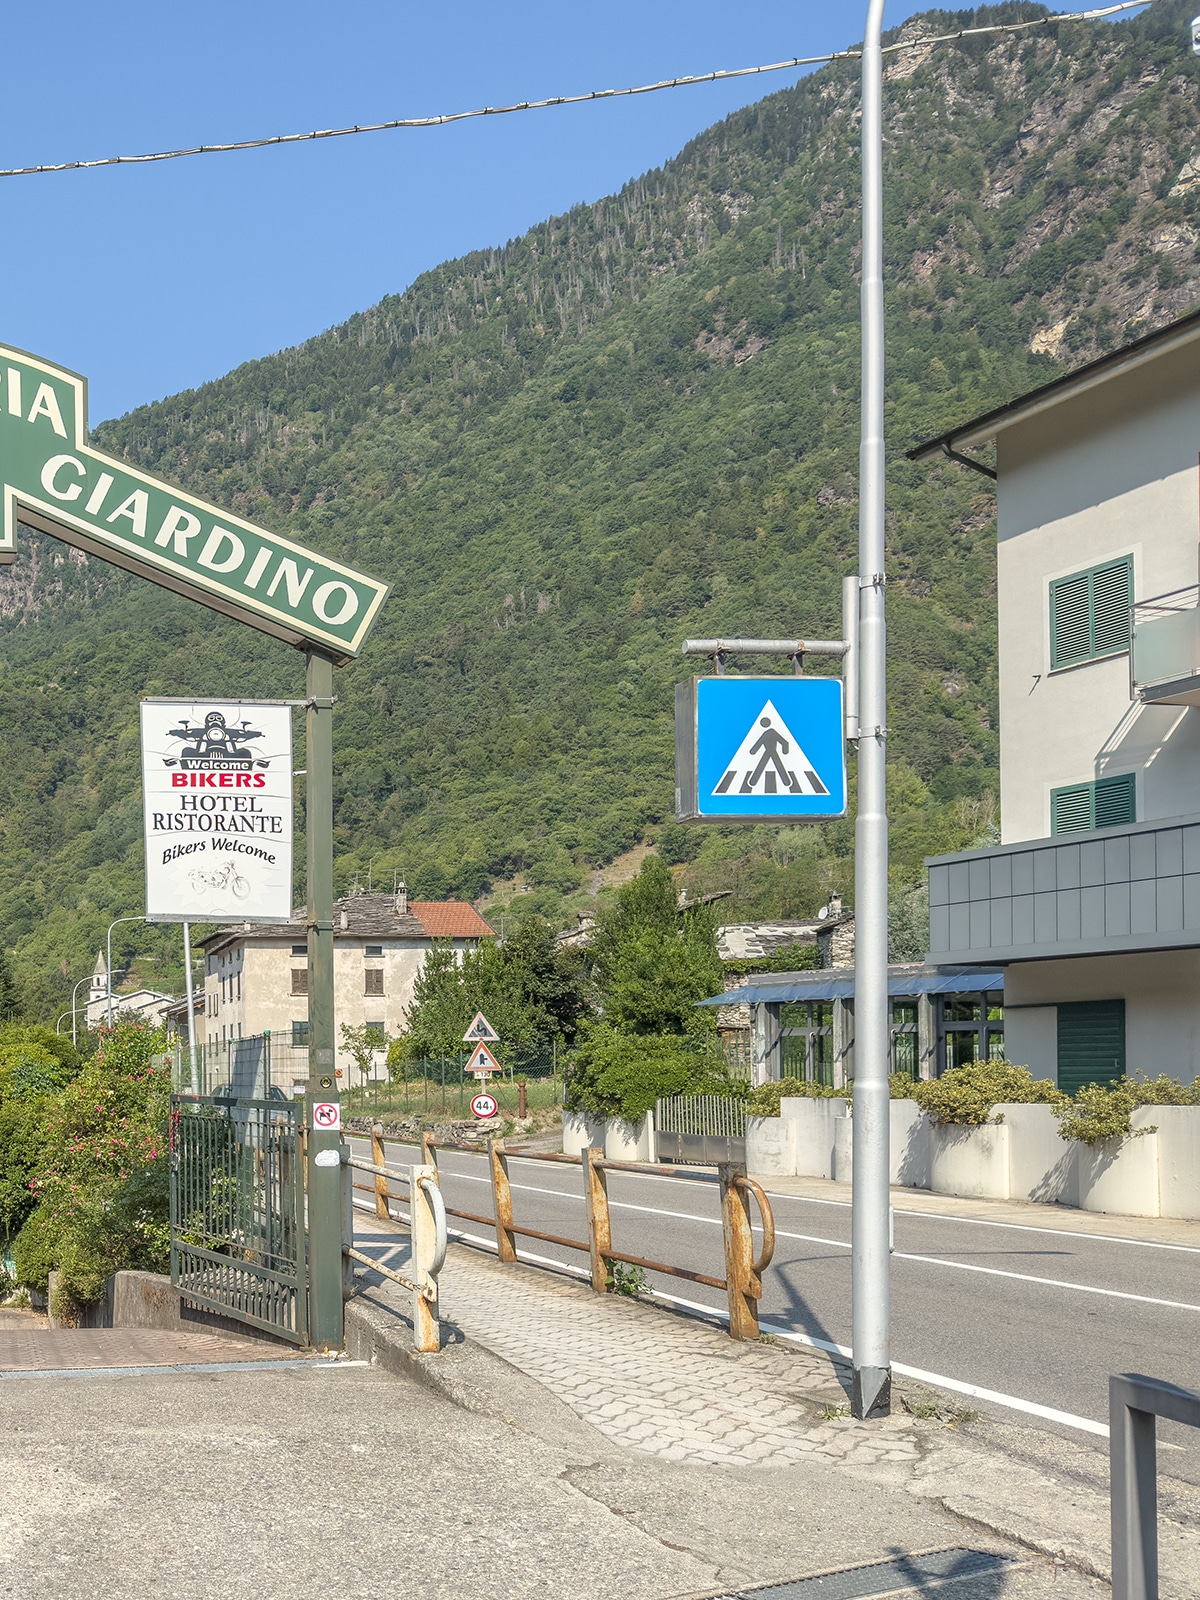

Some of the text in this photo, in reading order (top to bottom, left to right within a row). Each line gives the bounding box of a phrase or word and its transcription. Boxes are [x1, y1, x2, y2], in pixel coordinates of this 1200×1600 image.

[40, 454, 359, 625] GIARDINO
[186, 759, 250, 770] Welcome
[171, 773, 266, 788] BIKERS
[180, 795, 263, 813] HOTEL
[152, 813, 283, 834] RISTORANTE
[162, 837, 276, 865] Bikers Welcome
